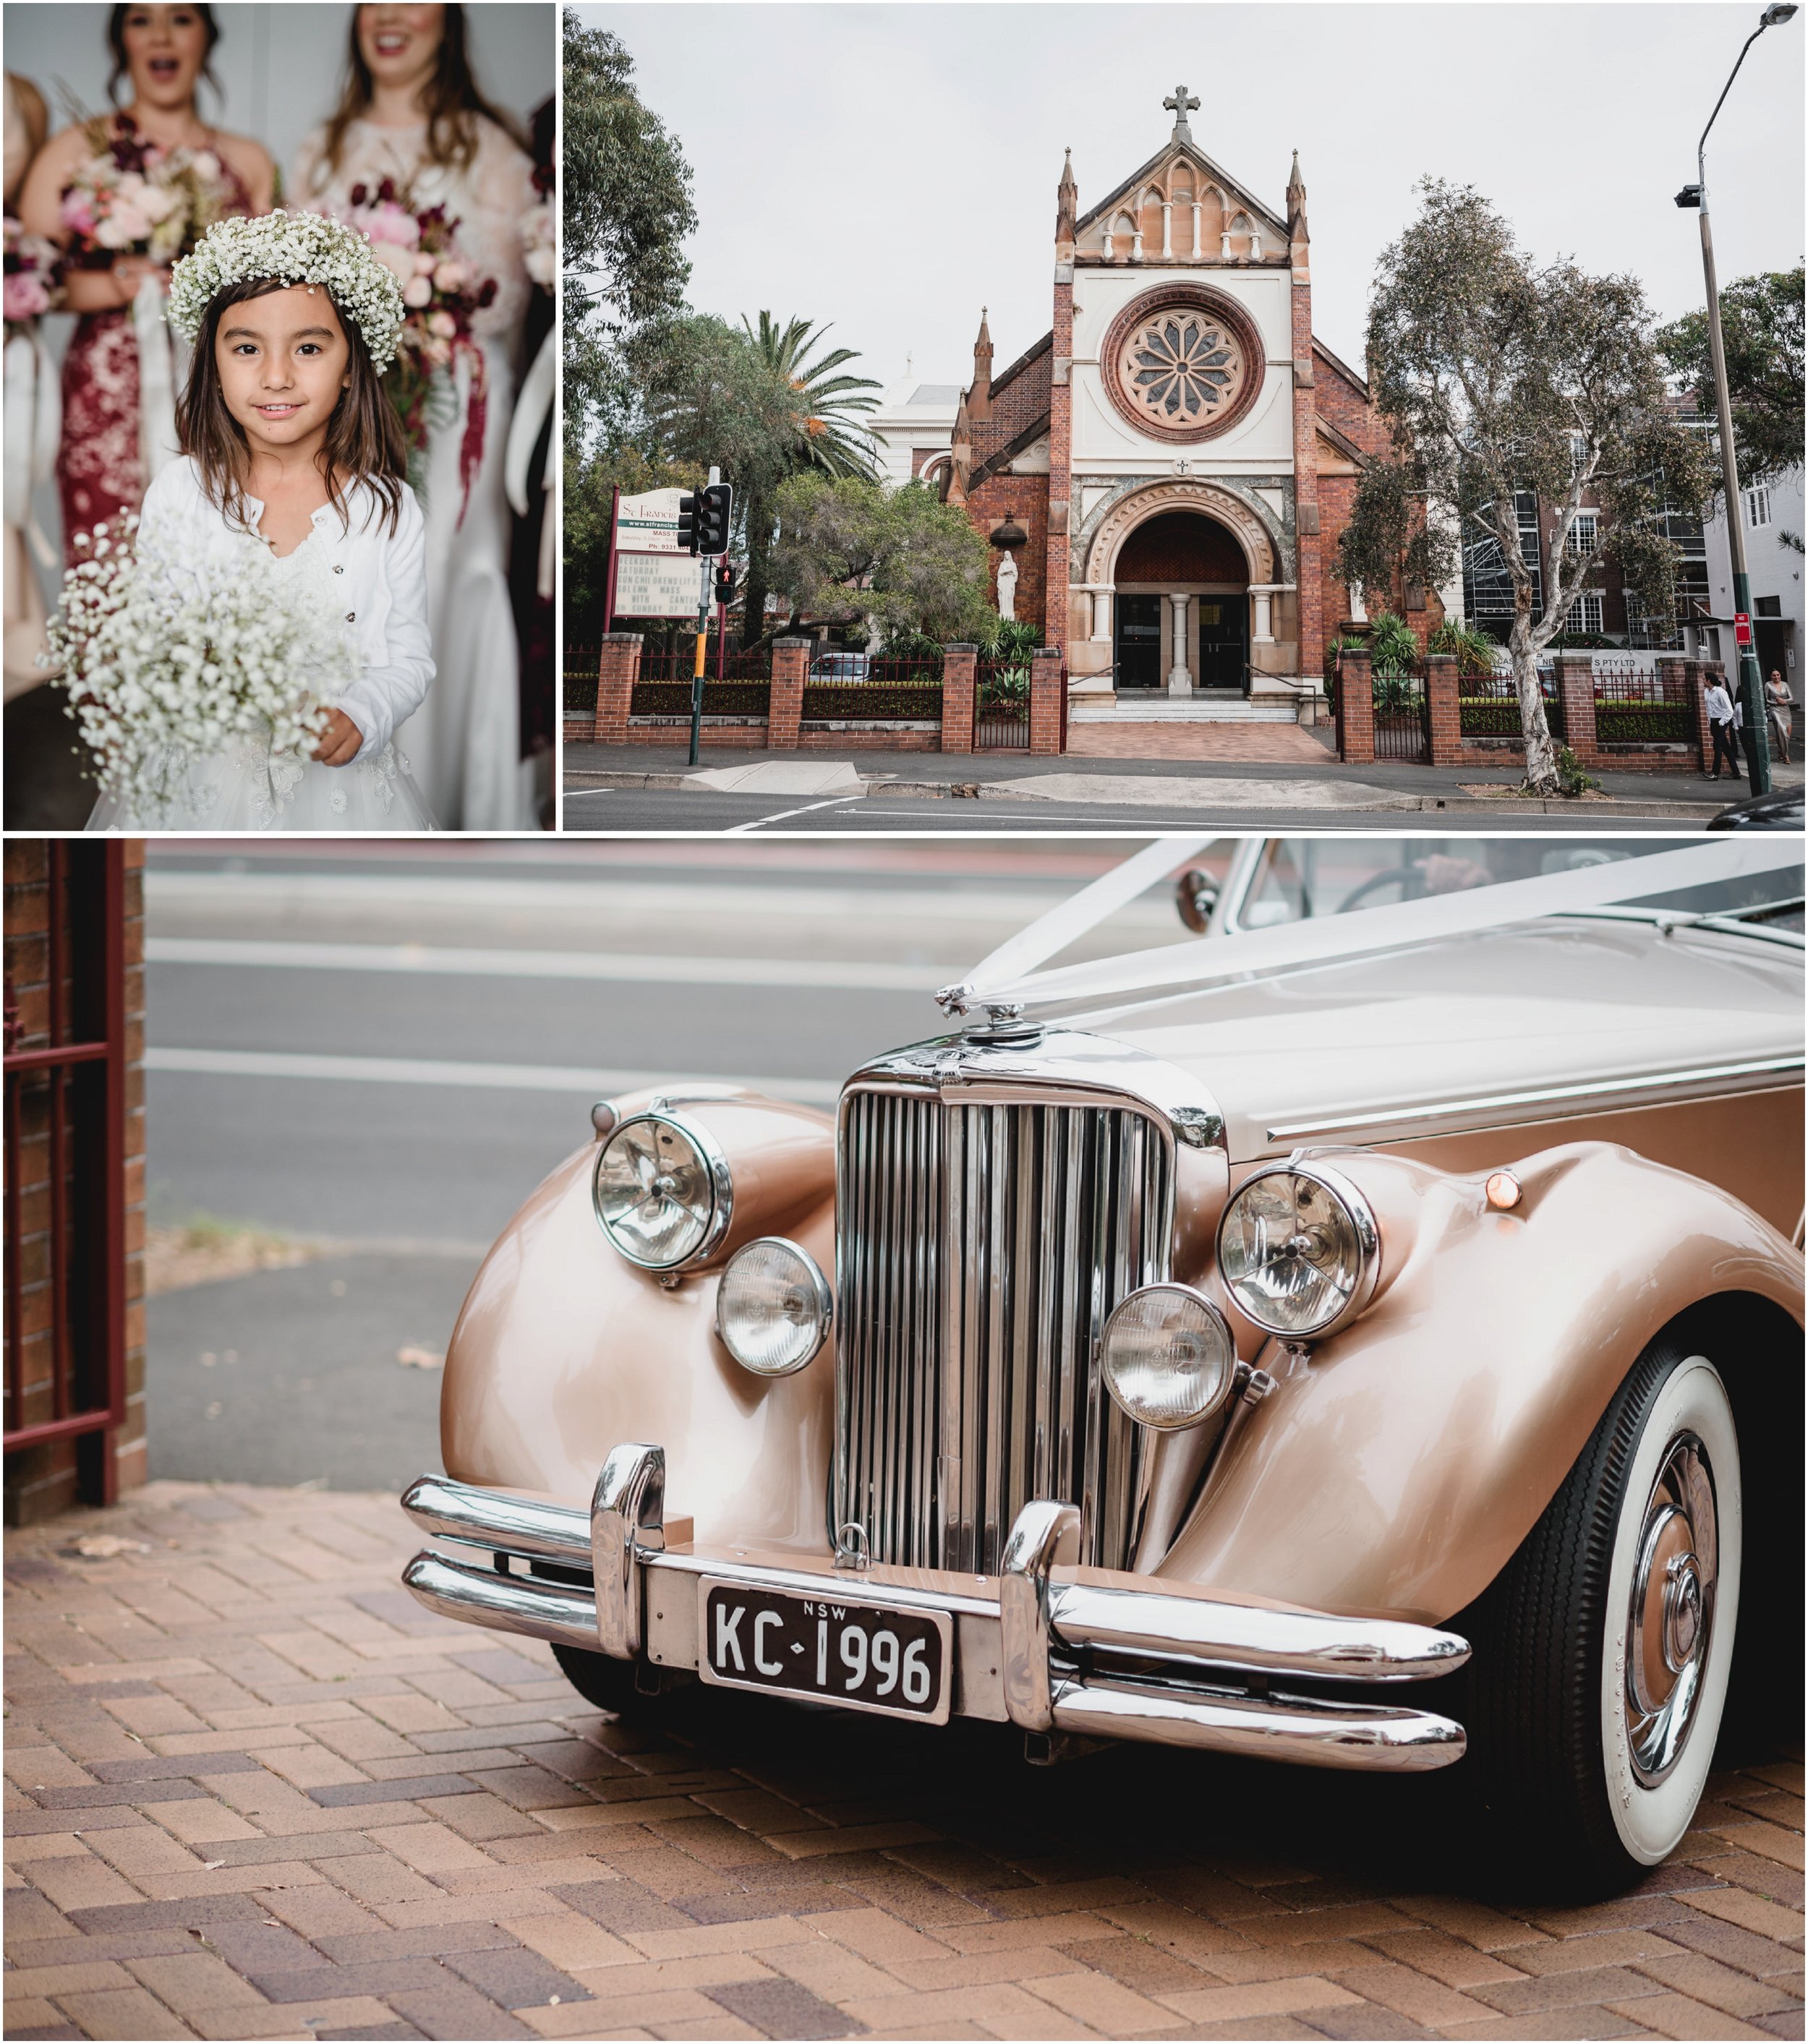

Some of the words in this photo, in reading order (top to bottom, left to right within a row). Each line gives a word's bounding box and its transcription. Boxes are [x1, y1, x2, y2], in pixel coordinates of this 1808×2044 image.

[623, 503, 636, 516] St
[640, 505, 676, 518] Francis
[628, 521, 678, 529] www.stfrancis-s
[618, 557, 660, 566] WEEKDAYS
[618, 566, 660, 575] SATURDAY
[618, 576, 633, 584] SUN
[618, 585, 648, 594] SOLEMN
[631, 595, 649, 604] WITH
[631, 604, 662, 613] SUNDAY
[684, 605, 699, 614] EAS
[803, 1601, 846, 1620] NSW
